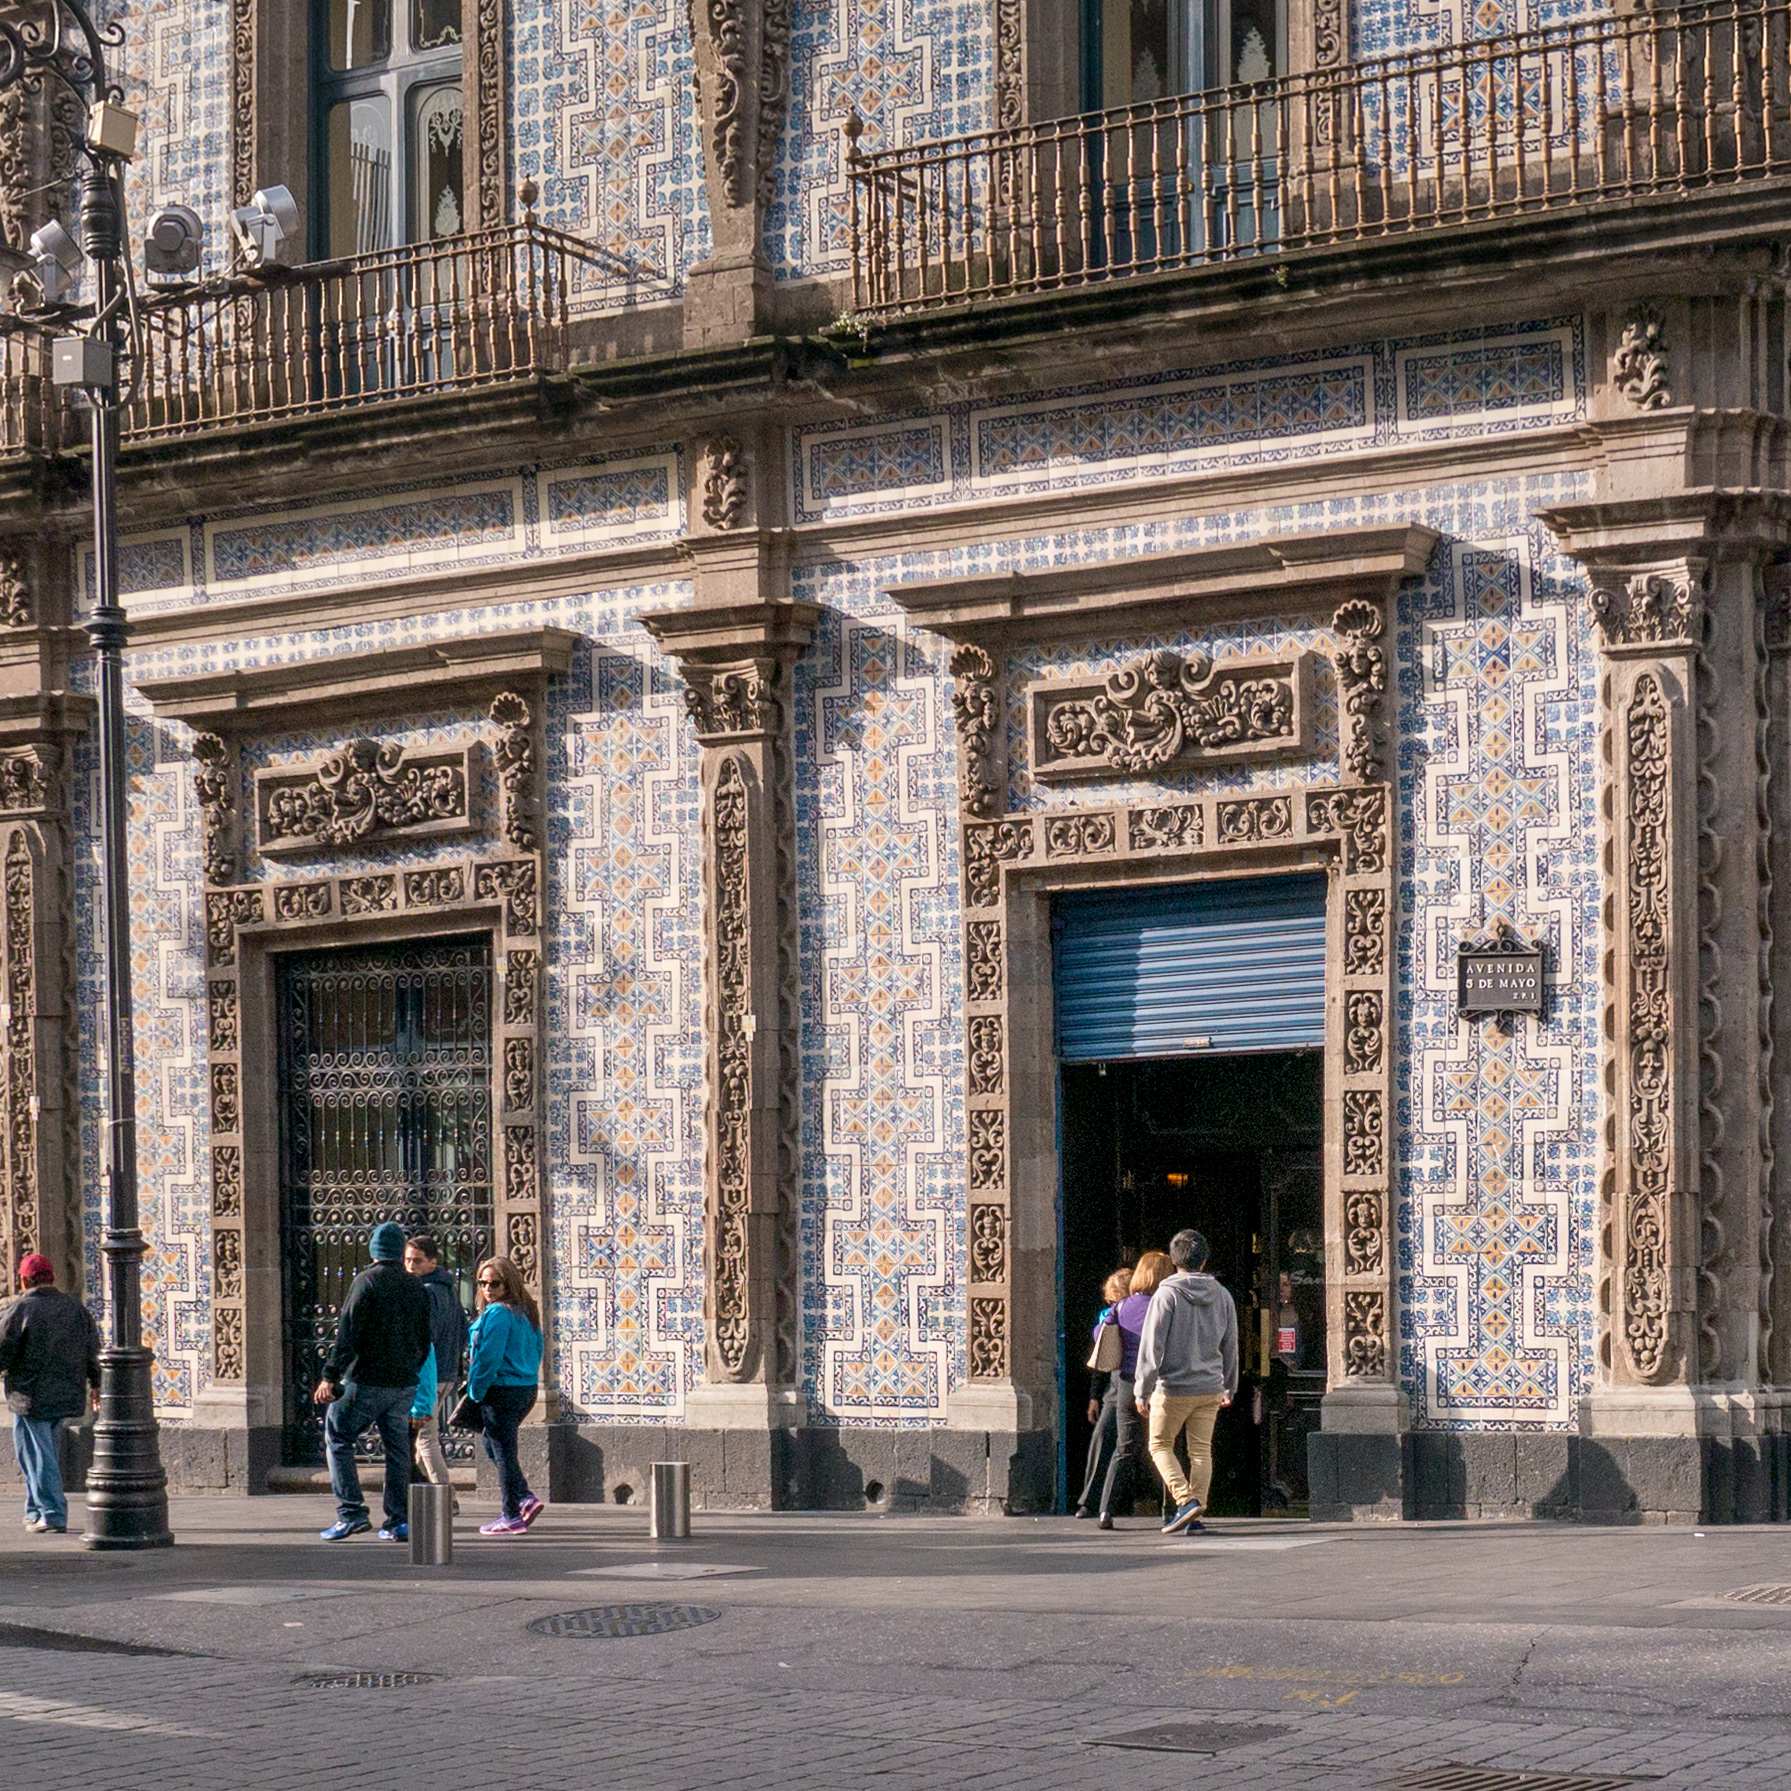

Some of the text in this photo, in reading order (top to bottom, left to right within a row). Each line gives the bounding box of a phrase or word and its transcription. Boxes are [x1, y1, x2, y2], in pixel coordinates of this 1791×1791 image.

[1466, 963, 1535, 974] AVENIDA
[1466, 978, 1536, 989] 5 DE MAYO
